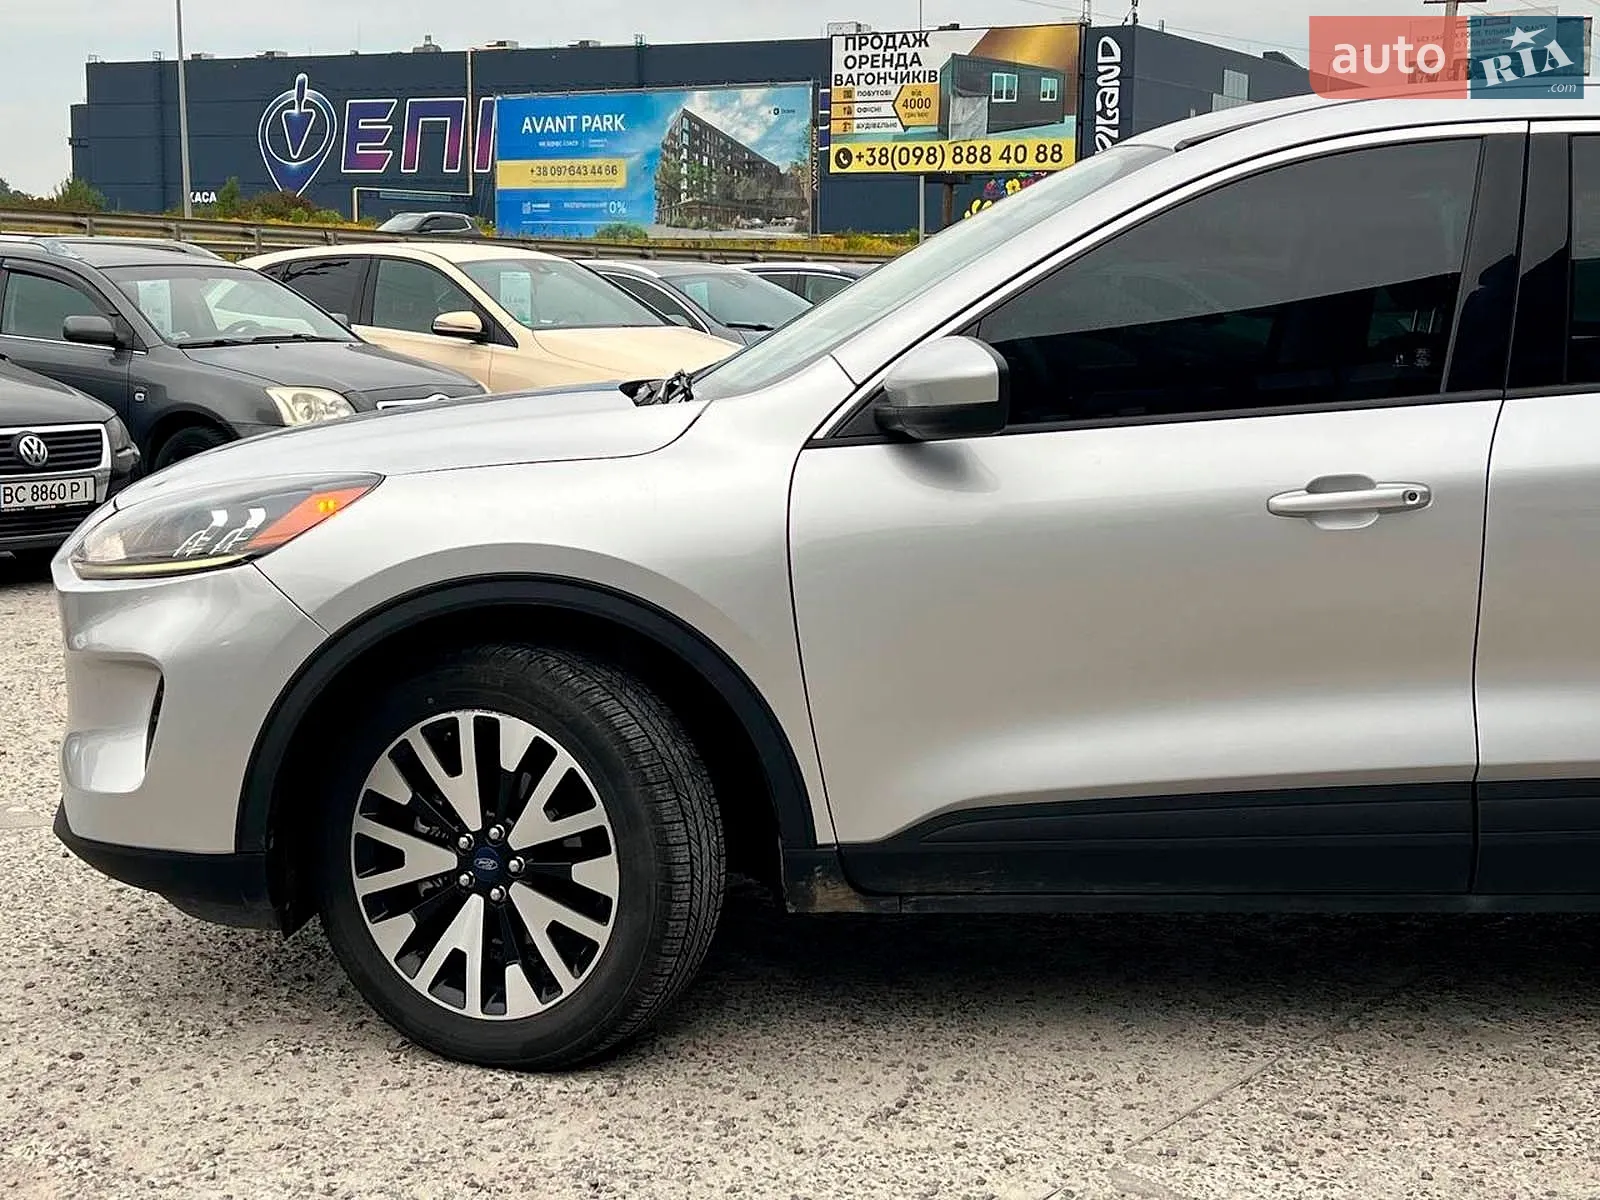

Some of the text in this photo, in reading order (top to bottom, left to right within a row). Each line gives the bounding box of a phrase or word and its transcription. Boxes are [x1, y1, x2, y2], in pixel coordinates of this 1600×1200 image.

[845, 33, 929, 52] ПРОДАЖ
[844, 52, 922, 70] ОРЕНДА
[834, 70, 938, 86] ВАГОНЧИКІВ
[902, 97, 931, 109] 4000
[522, 113, 626, 134] AVANT PARK
[856, 143, 1063, 170] +38(098) 888 40 88
[609, 201, 627, 213] 0%
[3, 481, 88, 504] BC 8860 PI
